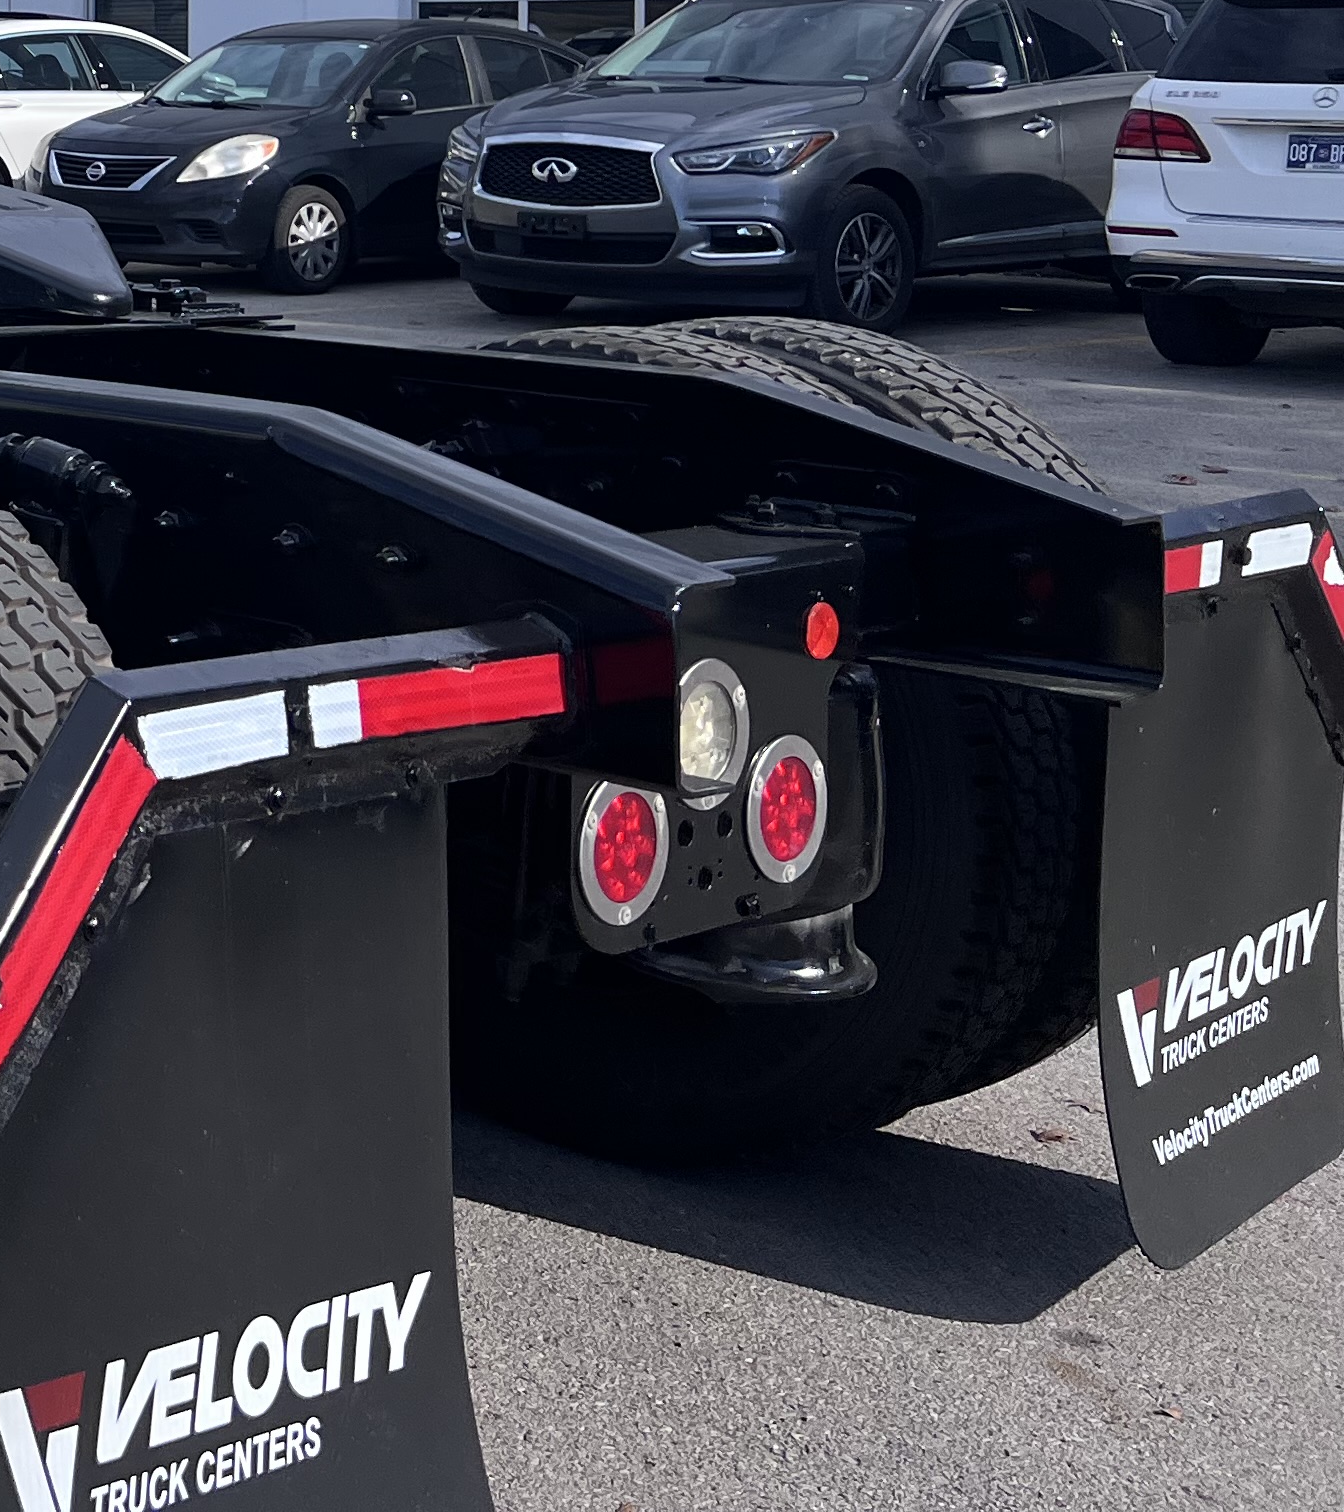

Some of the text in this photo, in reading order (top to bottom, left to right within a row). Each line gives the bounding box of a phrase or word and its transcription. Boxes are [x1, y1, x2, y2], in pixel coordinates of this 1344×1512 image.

[1163, 899, 1328, 1033] VELOCITY
[1160, 996, 1269, 1074] TRUCK CENTERS
[1151, 1054, 1320, 1166] VelocityTruckCenters.com
[96, 1270, 432, 1465] VELOCITY
[90, 1416, 321, 1512] TRUCK CENTERS
